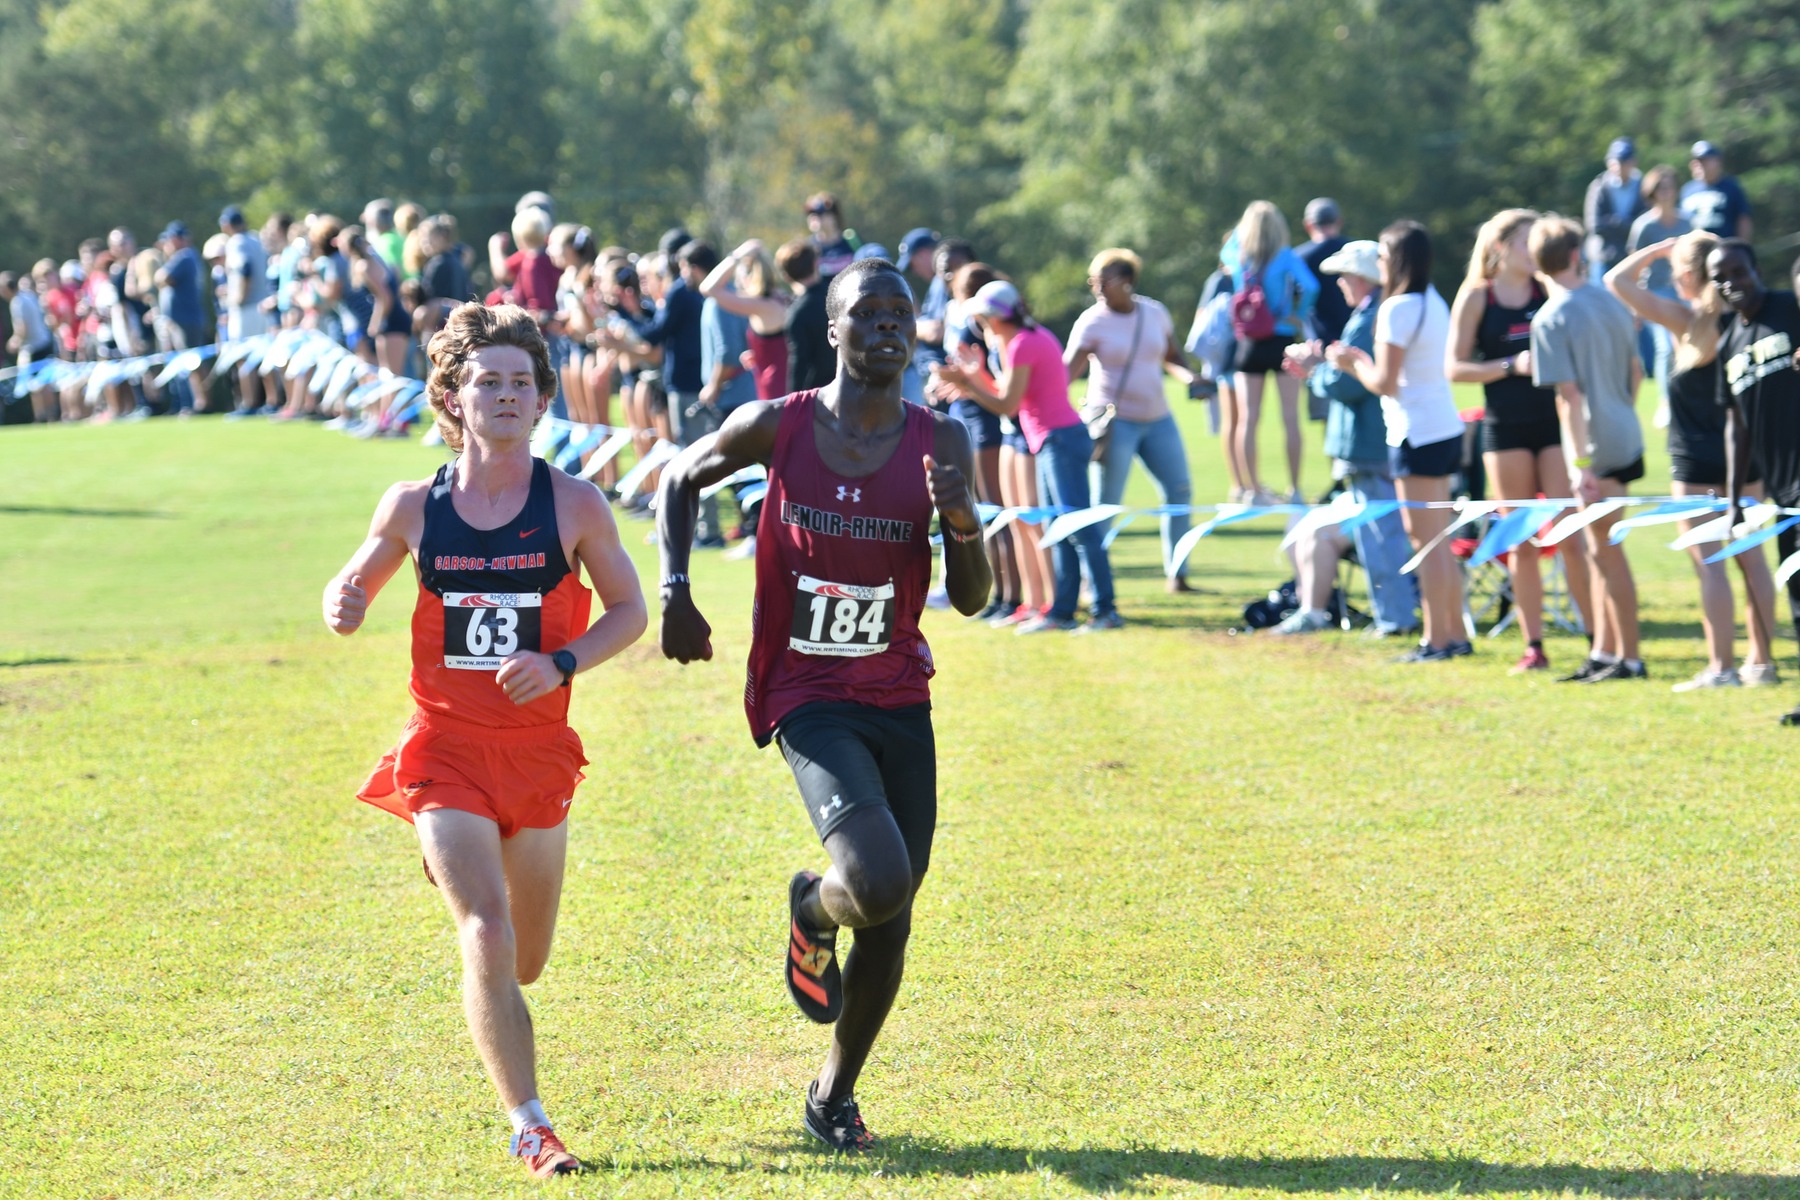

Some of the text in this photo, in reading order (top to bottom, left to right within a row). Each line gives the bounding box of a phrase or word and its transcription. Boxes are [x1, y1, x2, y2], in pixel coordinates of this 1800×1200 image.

[434, 552, 545, 570] CARSON-NEWMAN
[466, 608, 518, 656] 63
[809, 596, 885, 642] 184
